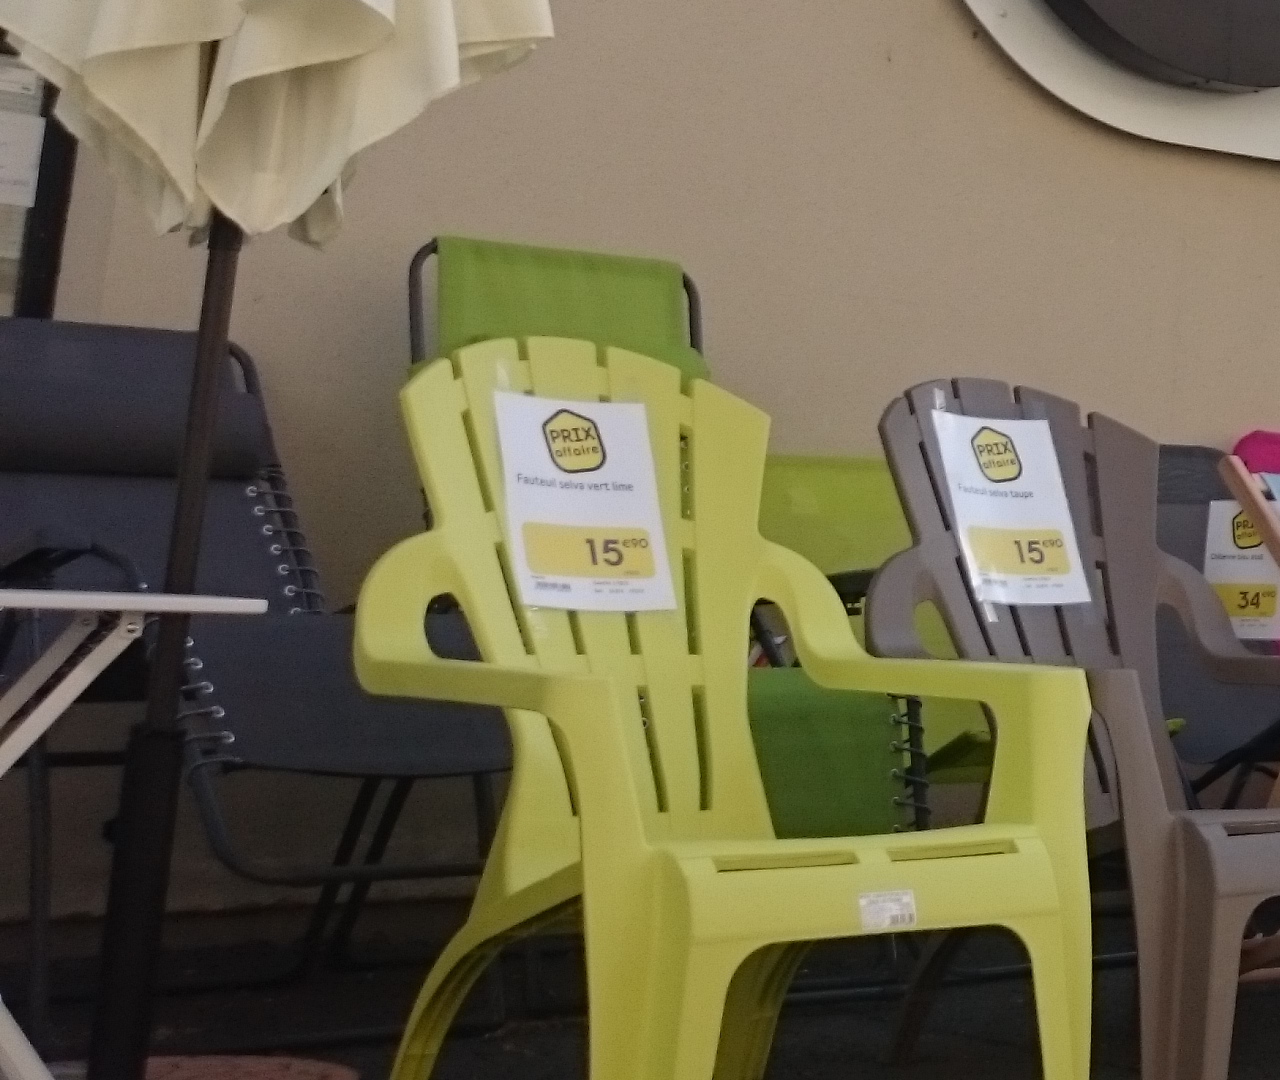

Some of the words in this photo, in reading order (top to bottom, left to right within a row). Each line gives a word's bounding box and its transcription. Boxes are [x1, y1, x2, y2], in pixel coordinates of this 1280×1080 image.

[549, 427, 597, 443] PRIX
[554, 445, 600, 458] affaire
[977, 441, 1013, 457] PRIX
[517, 474, 557, 488] Fauteuil
[587, 482, 611, 491] vert
[612, 482, 634, 492] lime
